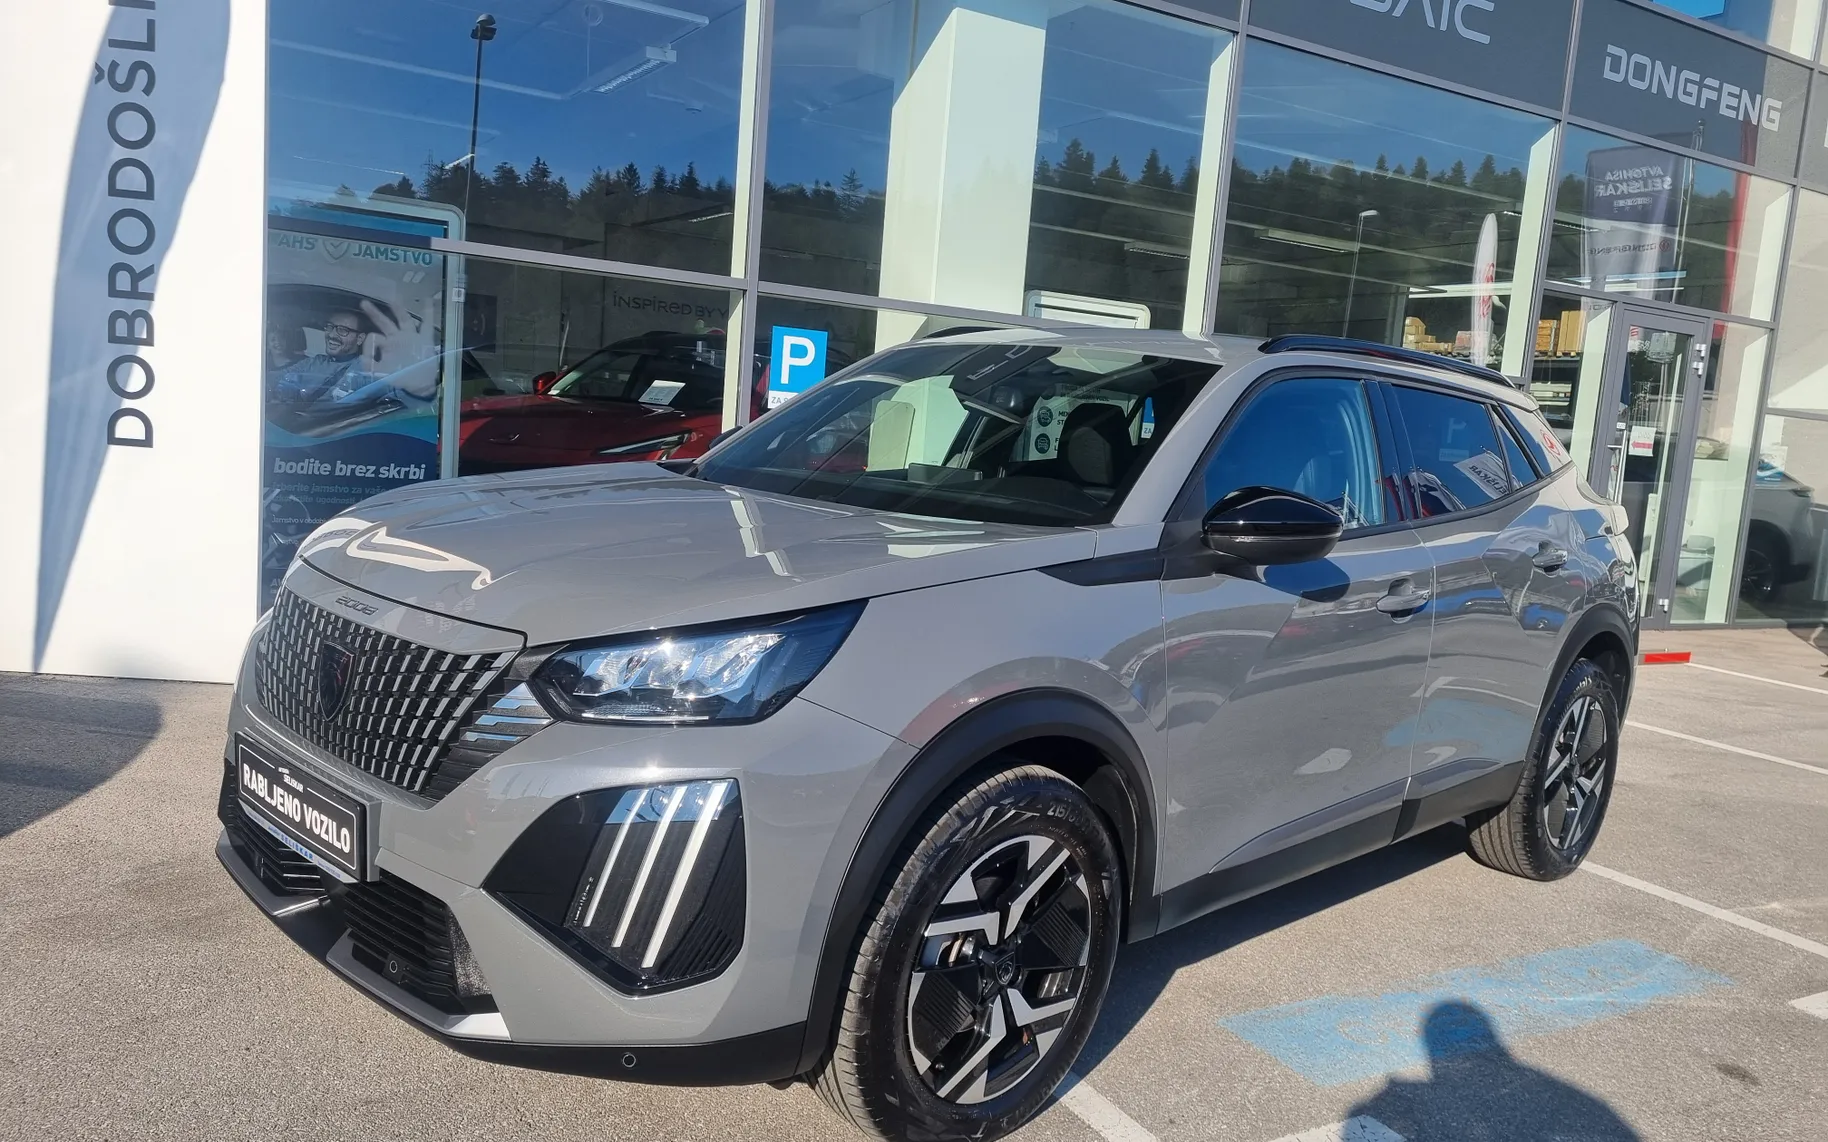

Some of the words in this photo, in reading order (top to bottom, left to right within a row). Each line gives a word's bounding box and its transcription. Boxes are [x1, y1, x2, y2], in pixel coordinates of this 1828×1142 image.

[1349, 0, 1496, 45] AIC
[1603, 43, 1783, 132] DONGFENG
[277, 234, 318, 251] AHS
[352, 244, 433, 266] JAMSTVO
[780, 335, 816, 385] P
[273, 457, 332, 476] bodite
[334, 460, 376, 478] brez
[378, 463, 426, 480] skrbi
[335, 595, 379, 616] 2008
[243, 763, 301, 823] RABLJENO
[303, 803, 351, 854] VOZILO
